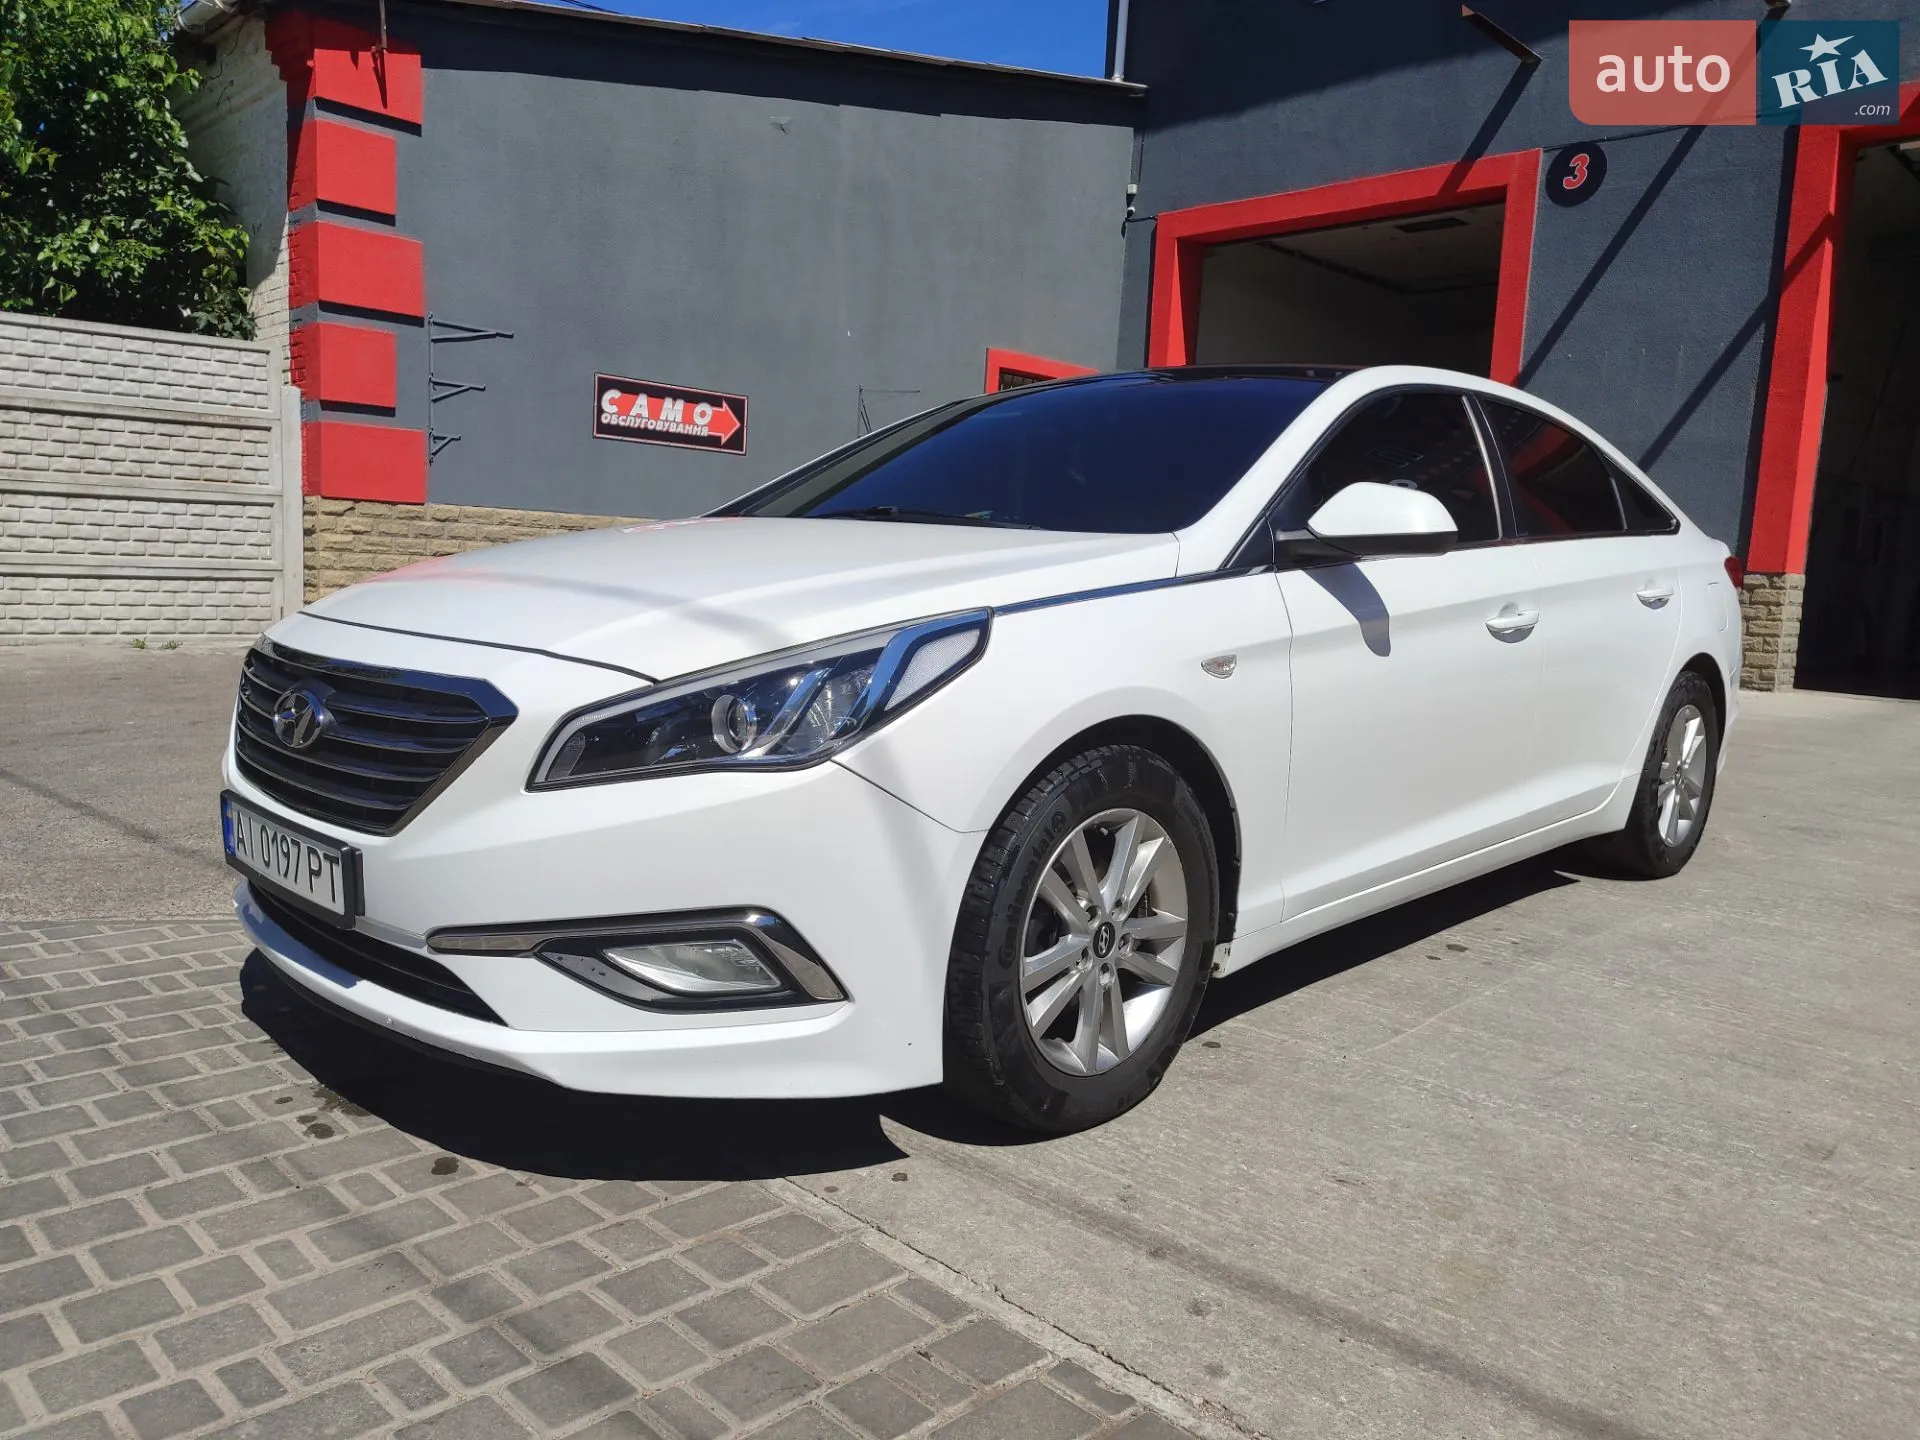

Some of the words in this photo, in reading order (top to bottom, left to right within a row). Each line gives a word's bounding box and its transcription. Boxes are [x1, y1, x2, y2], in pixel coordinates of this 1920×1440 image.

[1562, 153, 1590, 190] 3
[600, 412, 709, 437] ОБСЛУГОВУВАННЯ
[601, 389, 713, 426] САМО
[236, 811, 254, 862] AI
[260, 824, 302, 884] 0197
[306, 845, 340, 903] PT
